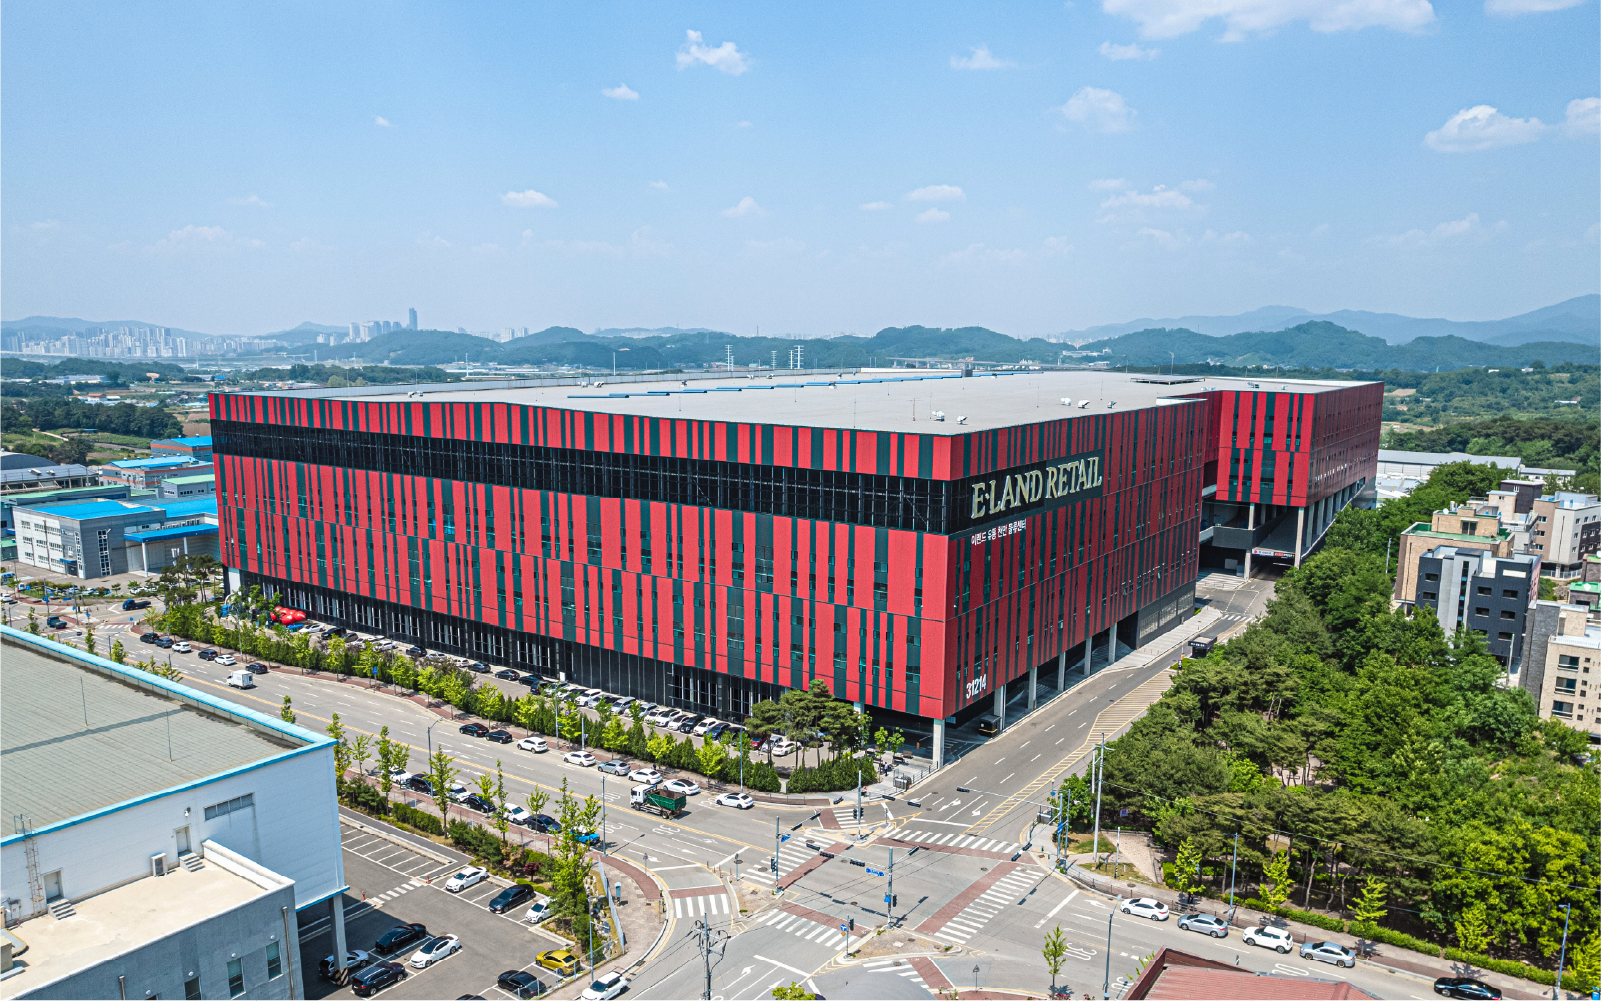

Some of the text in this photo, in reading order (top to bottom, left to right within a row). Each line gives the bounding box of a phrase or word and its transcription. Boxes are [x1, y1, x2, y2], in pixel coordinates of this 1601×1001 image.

[1045, 457, 1102, 499] RETAIL
[966, 673, 987, 699] 31214
[652, 824, 681, 836] 30
[1063, 942, 1097, 961] 30
